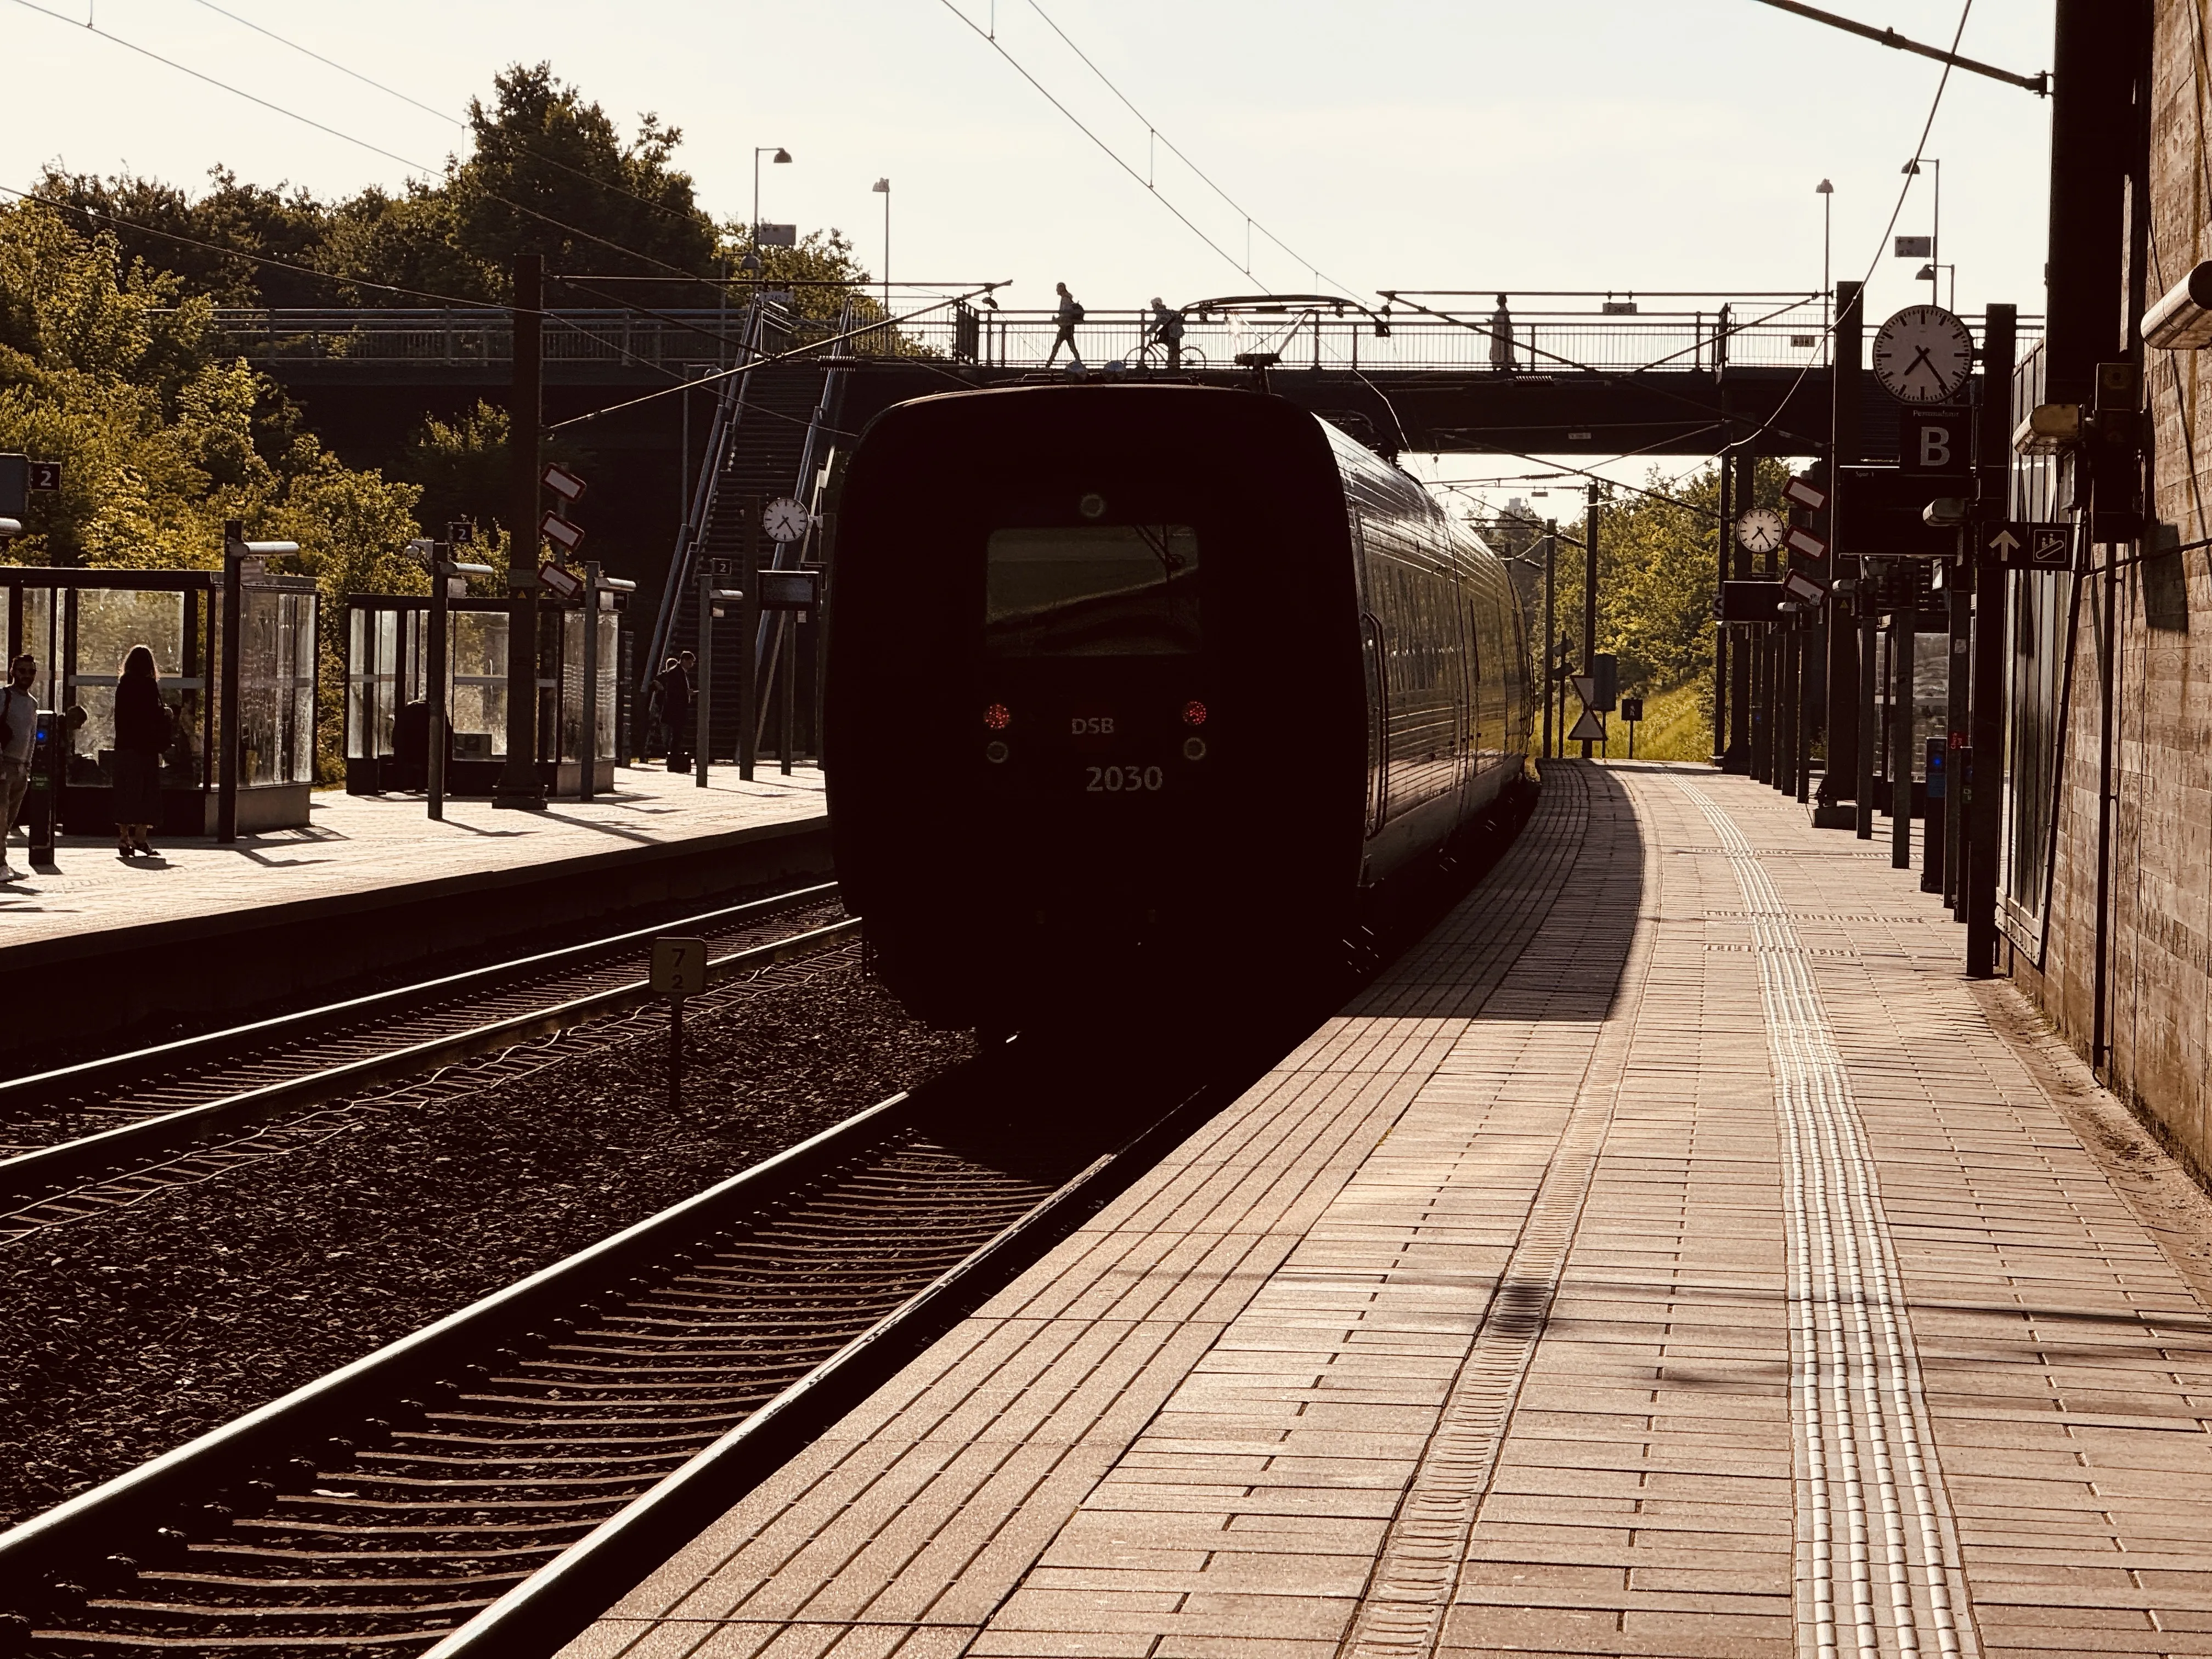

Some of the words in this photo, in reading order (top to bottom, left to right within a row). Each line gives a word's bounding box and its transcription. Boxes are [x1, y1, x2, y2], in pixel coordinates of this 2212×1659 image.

[1920, 426, 1950, 466] B
[40, 470, 52, 487] 2
[458, 528, 467, 540] 2
[719, 563, 726, 572] 2
[1071, 717, 1115, 735] DSB
[1086, 765, 1163, 792] 2030
[672, 948, 686, 967] 7
[672, 974, 684, 989] 2
